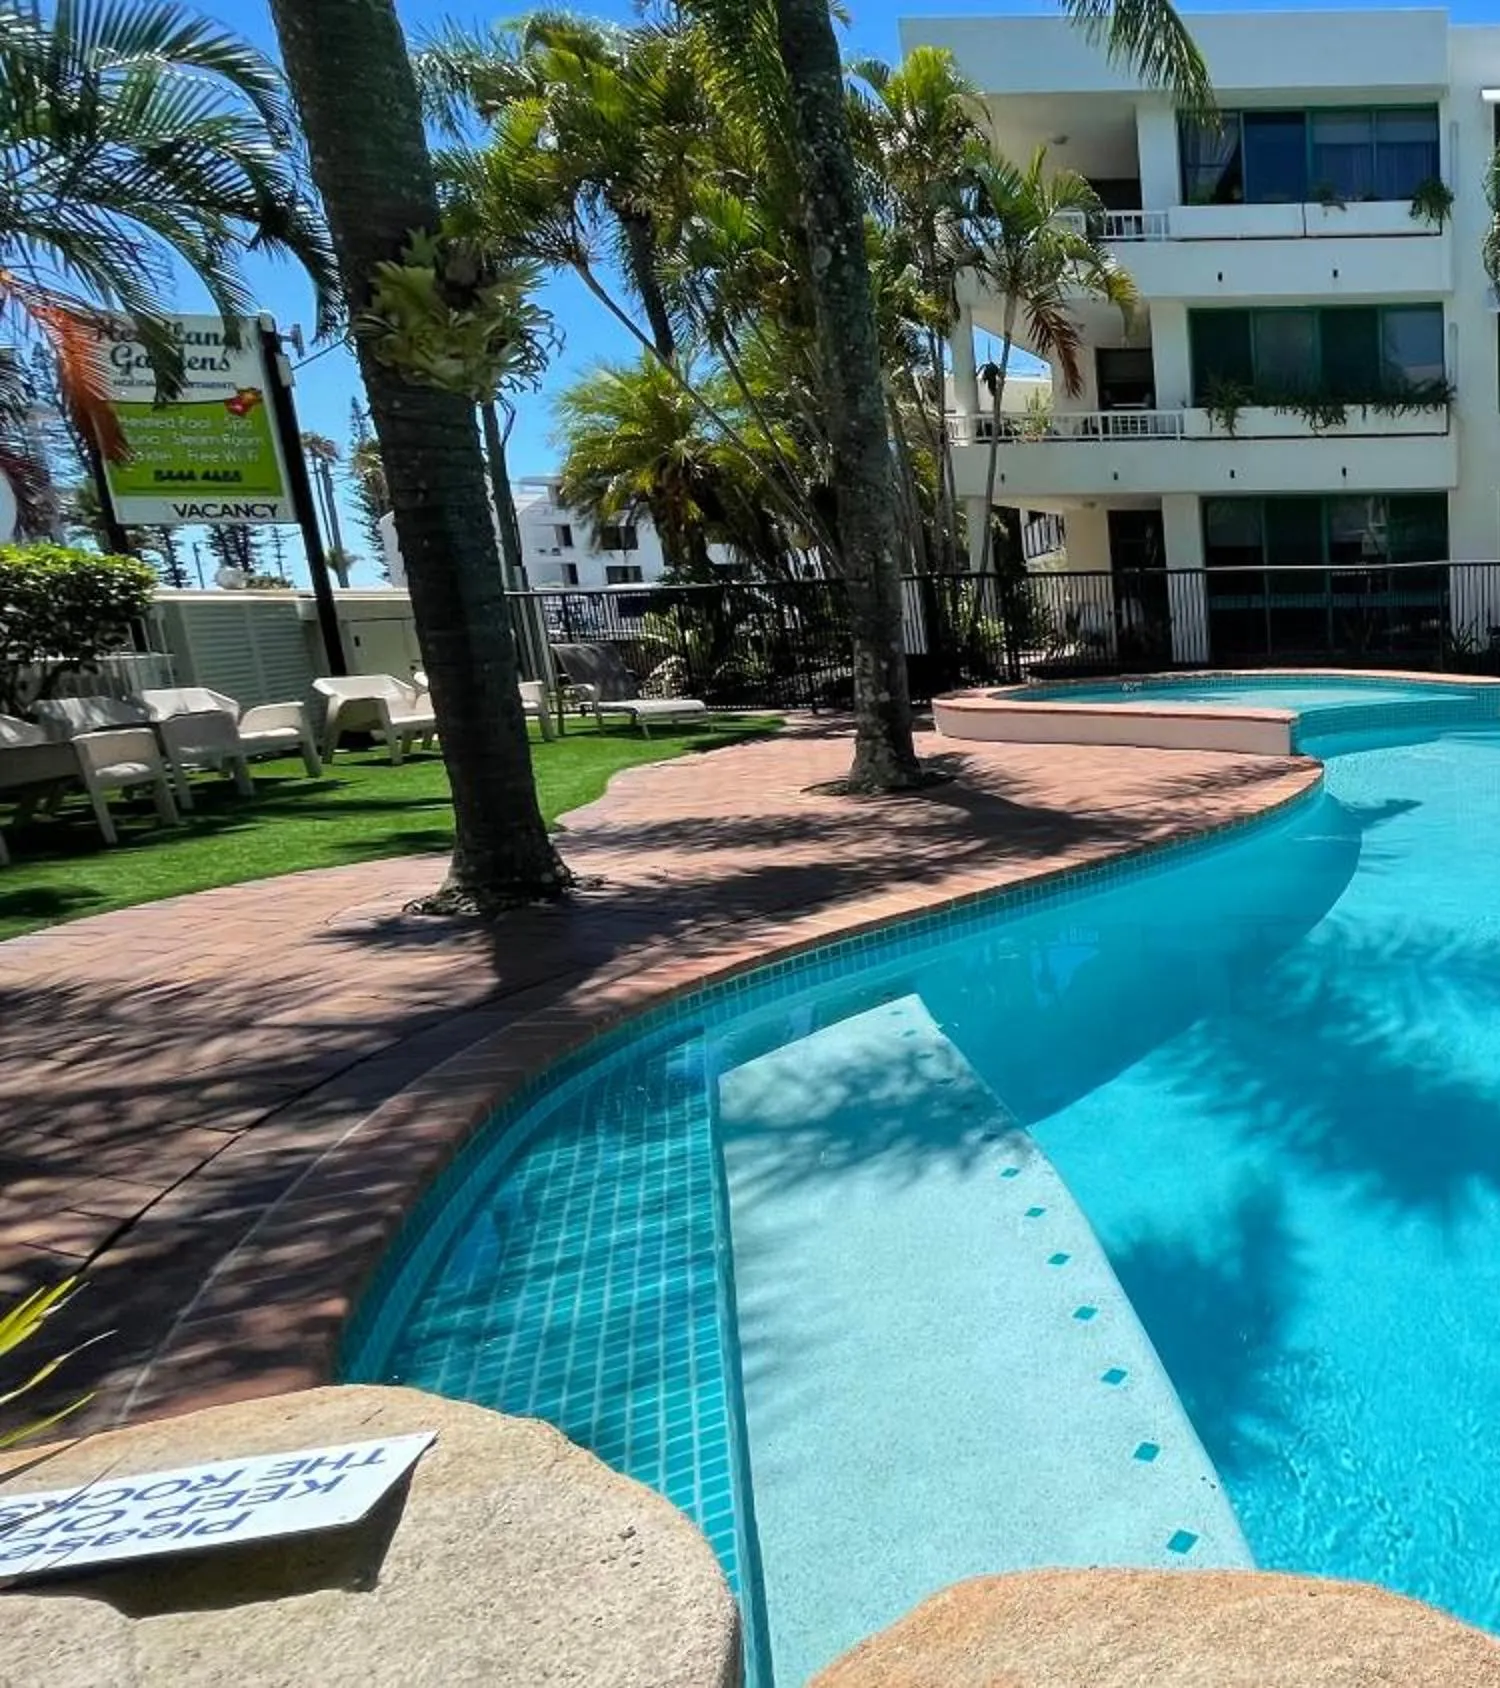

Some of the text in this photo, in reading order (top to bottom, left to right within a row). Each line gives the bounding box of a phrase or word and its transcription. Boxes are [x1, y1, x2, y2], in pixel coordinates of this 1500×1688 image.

[110, 343, 231, 375] Gaens
[172, 503, 278, 519] VACANCY
[255, 1448, 386, 1482] THE
[143, 1474, 347, 1520] KEEP
